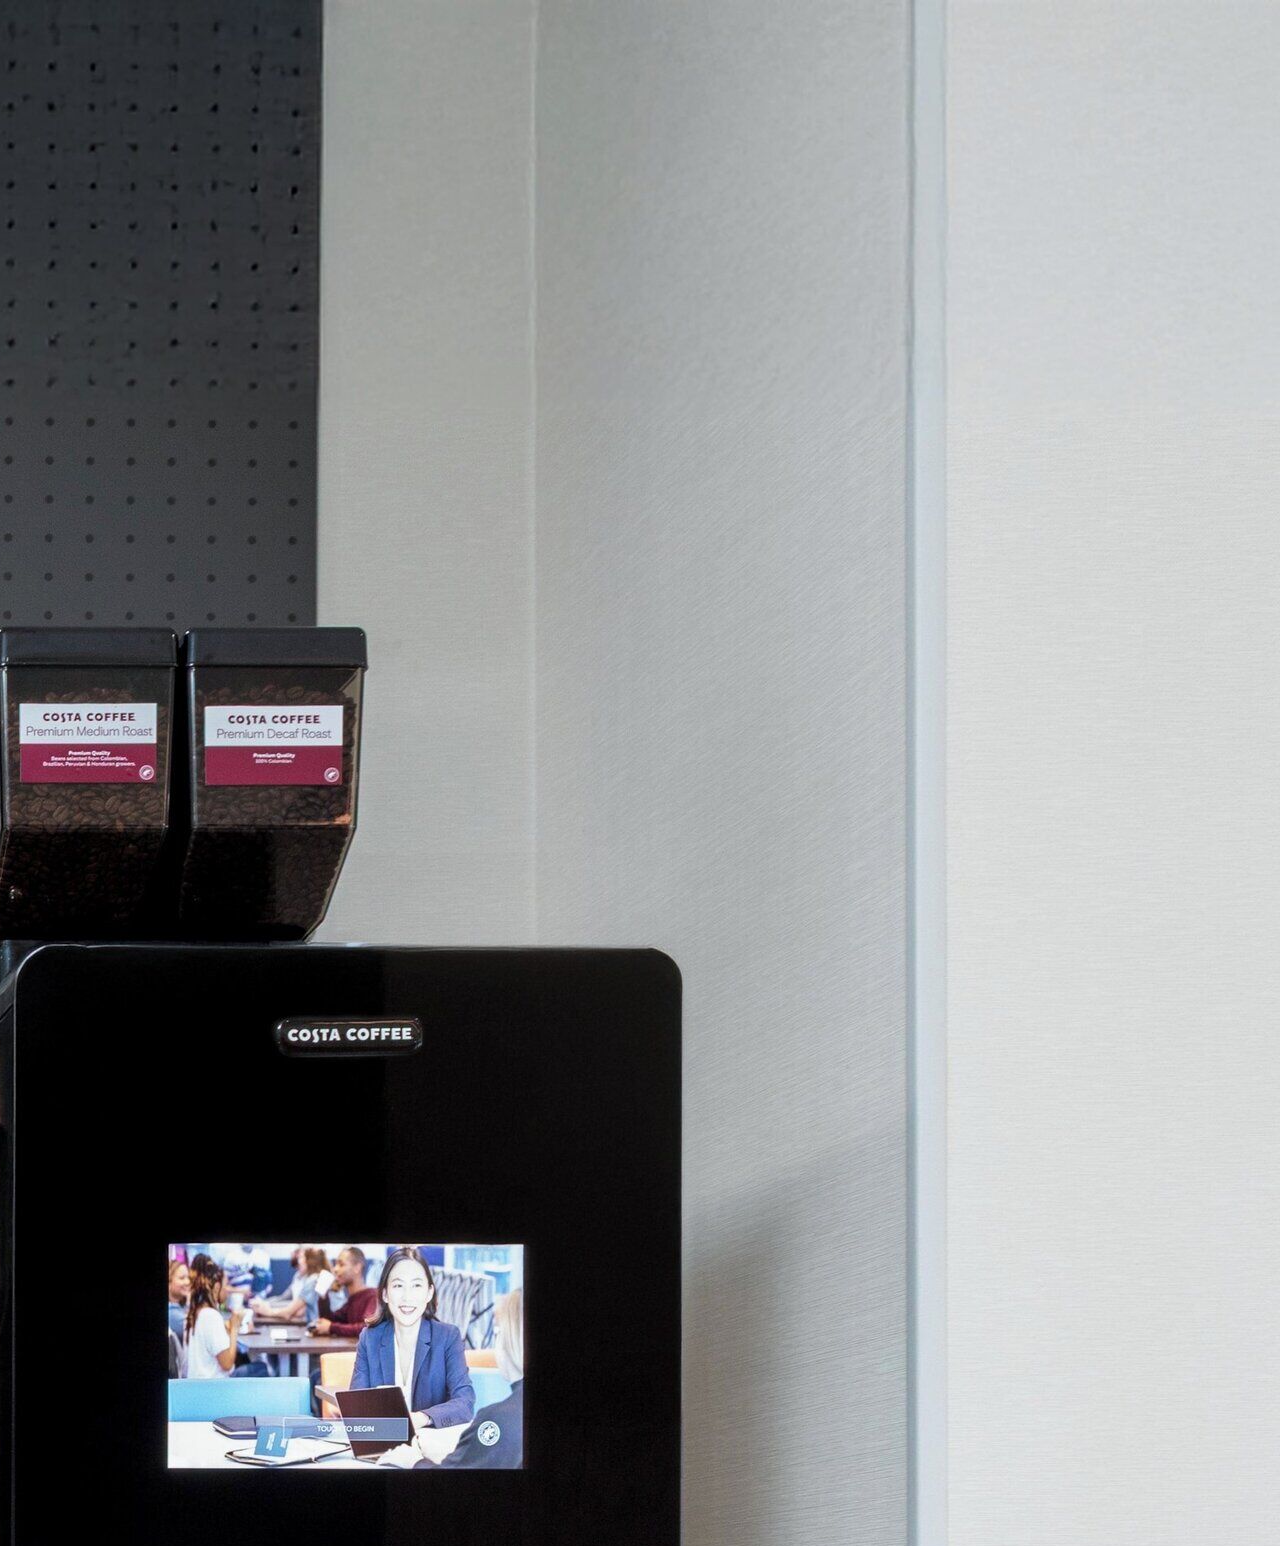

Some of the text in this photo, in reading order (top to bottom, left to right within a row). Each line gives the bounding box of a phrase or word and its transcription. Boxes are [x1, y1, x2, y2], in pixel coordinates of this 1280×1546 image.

[42, 712, 136, 723] COSTA COFFEE
[228, 715, 321, 725] COSTA COFFEE
[26, 725, 153, 737] Premium Medium Roast
[216, 728, 332, 739] Premium Decaf Roast
[287, 1027, 412, 1043] COSTA COFFEE
